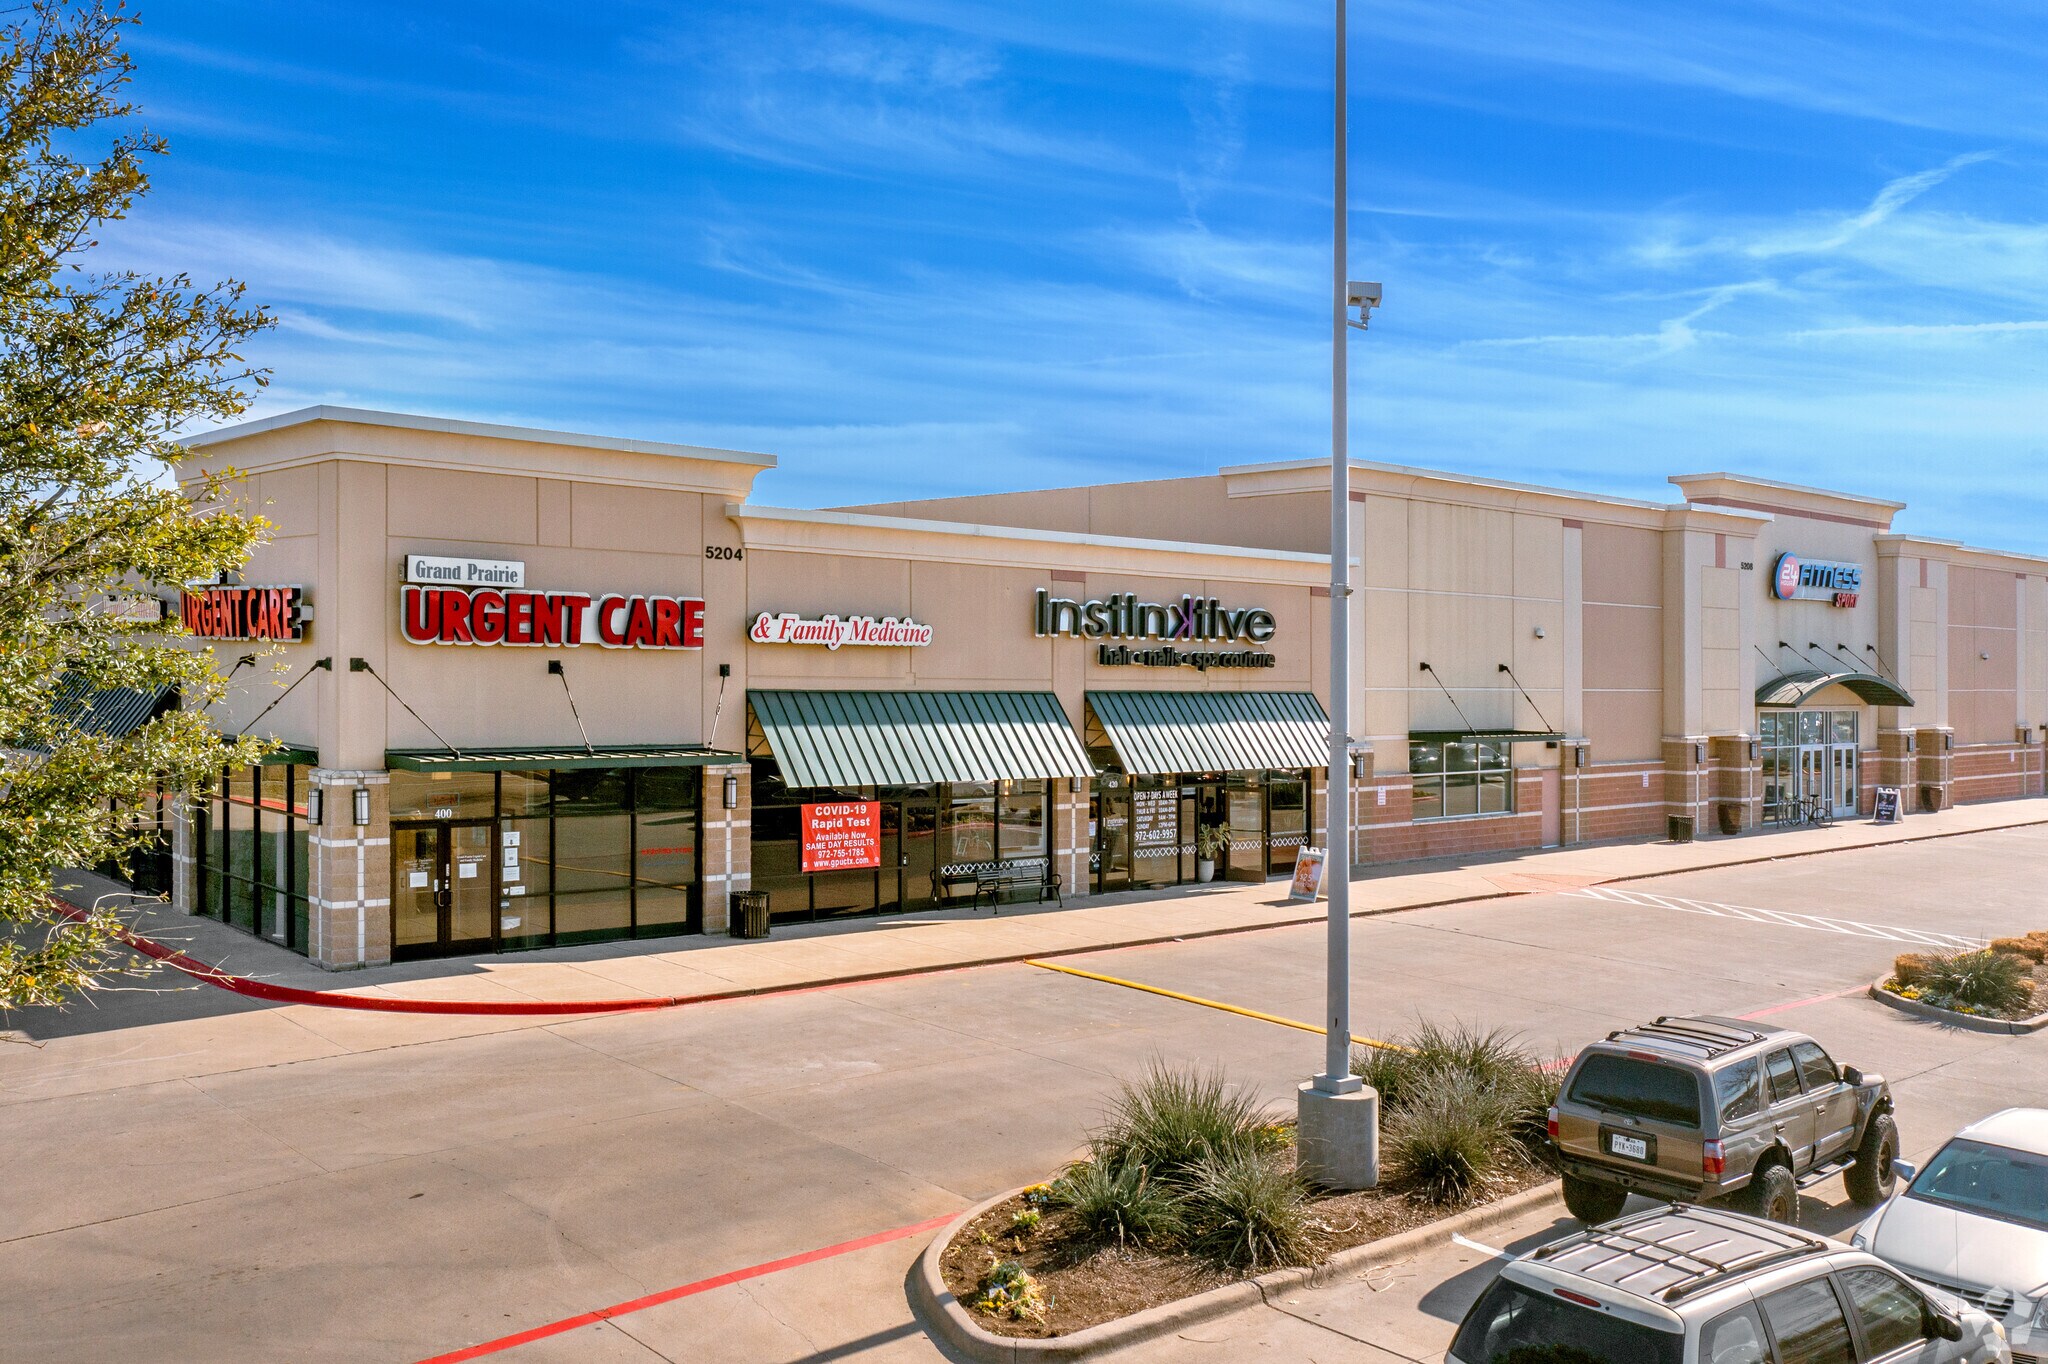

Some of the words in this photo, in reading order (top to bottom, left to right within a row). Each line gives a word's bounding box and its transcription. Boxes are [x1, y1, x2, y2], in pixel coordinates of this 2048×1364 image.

[705, 546, 743, 561] 5204
[415, 560, 461, 580] Grand
[467, 563, 519, 583] Prairie
[1781, 564, 1798, 586] 24
[1799, 564, 1862, 589] FITNESS
[1836, 592, 1859, 608] SPORT
[180, 588, 242, 638] URGENT
[247, 587, 293, 638] CARE
[405, 588, 591, 644] URGENT
[600, 596, 705, 648] CARE
[753, 616, 771, 639] &
[777, 618, 845, 647] Family
[848, 620, 930, 643] Medicine
[1098, 644, 1133, 666] hair
[1143, 646, 1182, 667] nails
[1192, 650, 1220, 671] spa
[1220, 651, 1276, 668] couture
[1134, 791, 1147, 800] OPEN
[1166, 790, 1178, 798] WEEK
[435, 809, 452, 819] 400
[815, 804, 867, 816] COVID-19
[811, 818, 843, 830] Rapid
[847, 817, 870, 827] Test
[816, 832, 849, 841] Available
[1135, 829, 1177, 841] 972-602-9957
[806, 842, 826, 850] SAME
[828, 841, 842, 849] DAY
[844, 838, 875, 847] RESULTS
[818, 848, 865, 858] 972-755-1785
